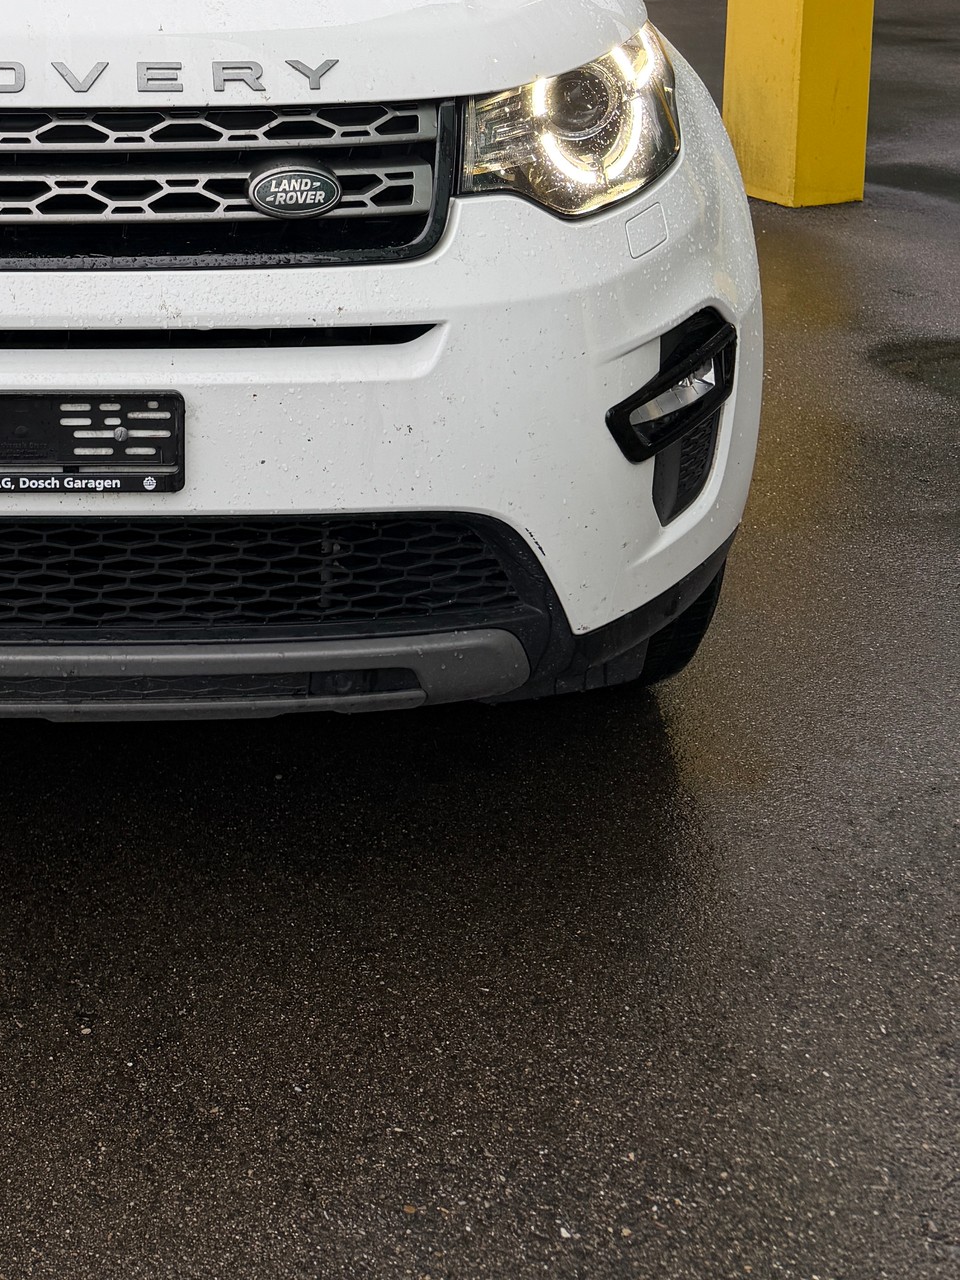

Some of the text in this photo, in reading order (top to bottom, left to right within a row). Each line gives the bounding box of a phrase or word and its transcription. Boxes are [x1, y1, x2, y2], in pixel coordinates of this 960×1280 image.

[270, 178, 311, 192] LAND
[275, 190, 326, 205] ROVER
[19, 477, 62, 489] Dosch
[63, 477, 121, 491] Garagen
